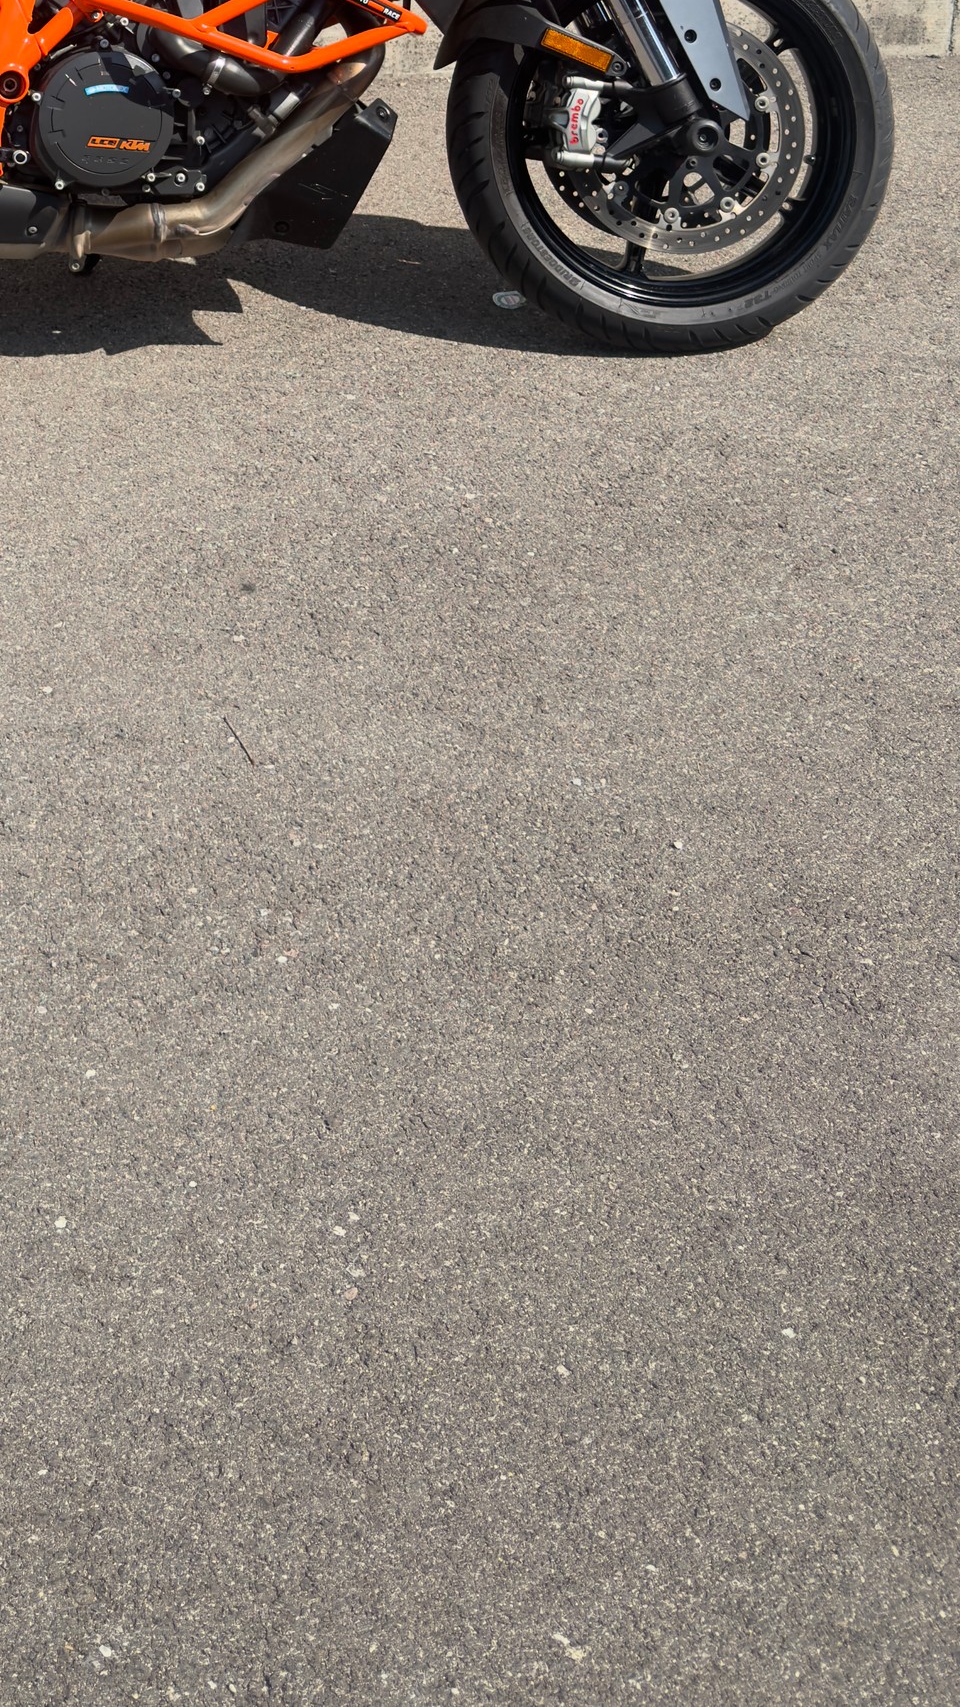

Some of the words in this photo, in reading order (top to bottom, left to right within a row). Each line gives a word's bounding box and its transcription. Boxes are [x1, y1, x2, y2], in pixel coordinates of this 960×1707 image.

[382, 7, 401, 21] RACE
[569, 98, 584, 145] brembo
[120, 139, 151, 151] KTM
